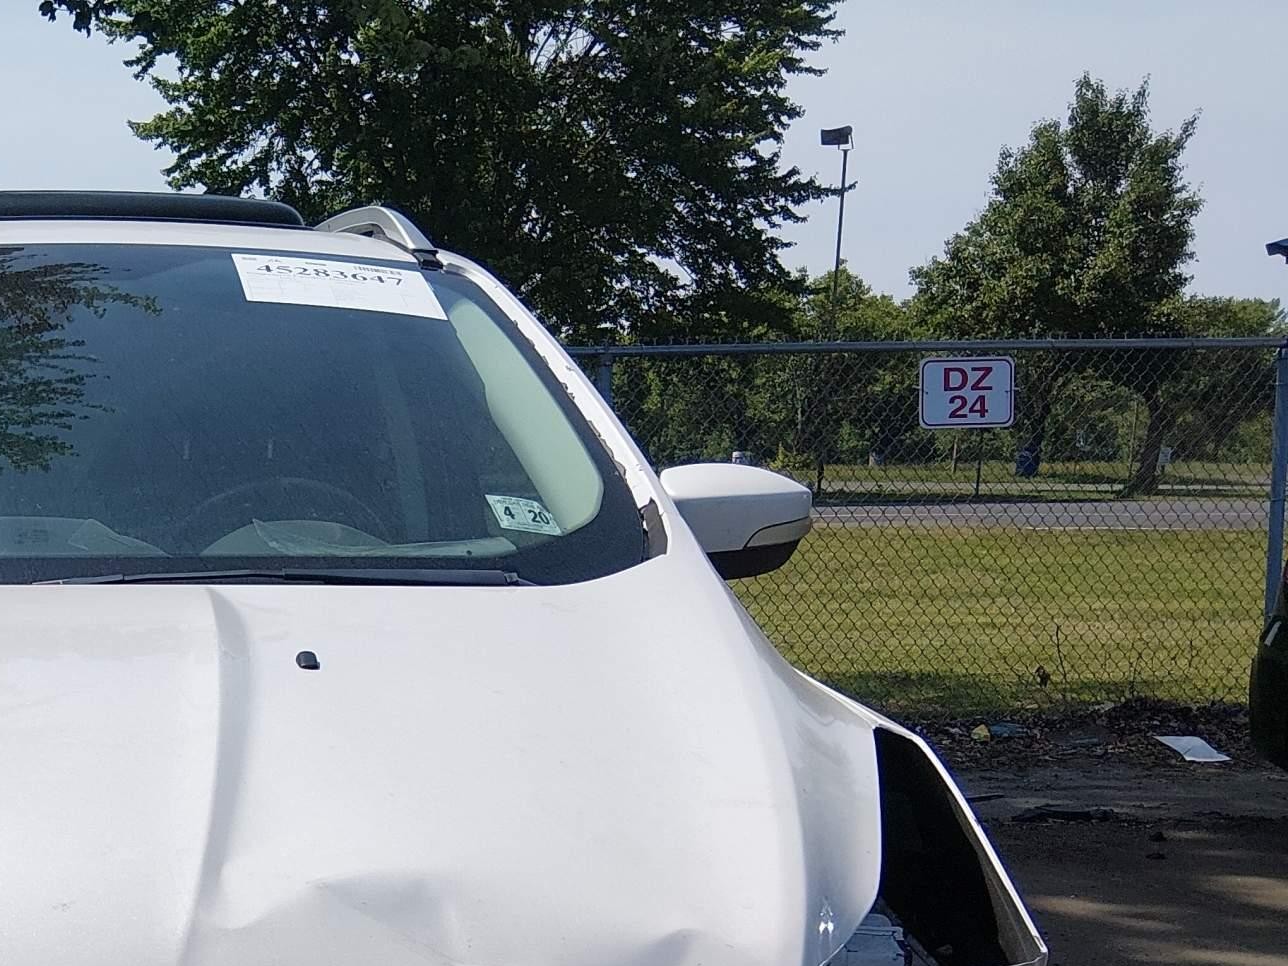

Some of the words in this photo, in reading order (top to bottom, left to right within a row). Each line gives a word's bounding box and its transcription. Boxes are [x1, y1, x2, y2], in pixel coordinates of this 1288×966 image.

[257, 265, 402, 286] 45283647
[944, 367, 993, 391] DZ
[948, 395, 989, 419] 24
[503, 506, 515, 520] 4
[528, 510, 550, 525] 20
